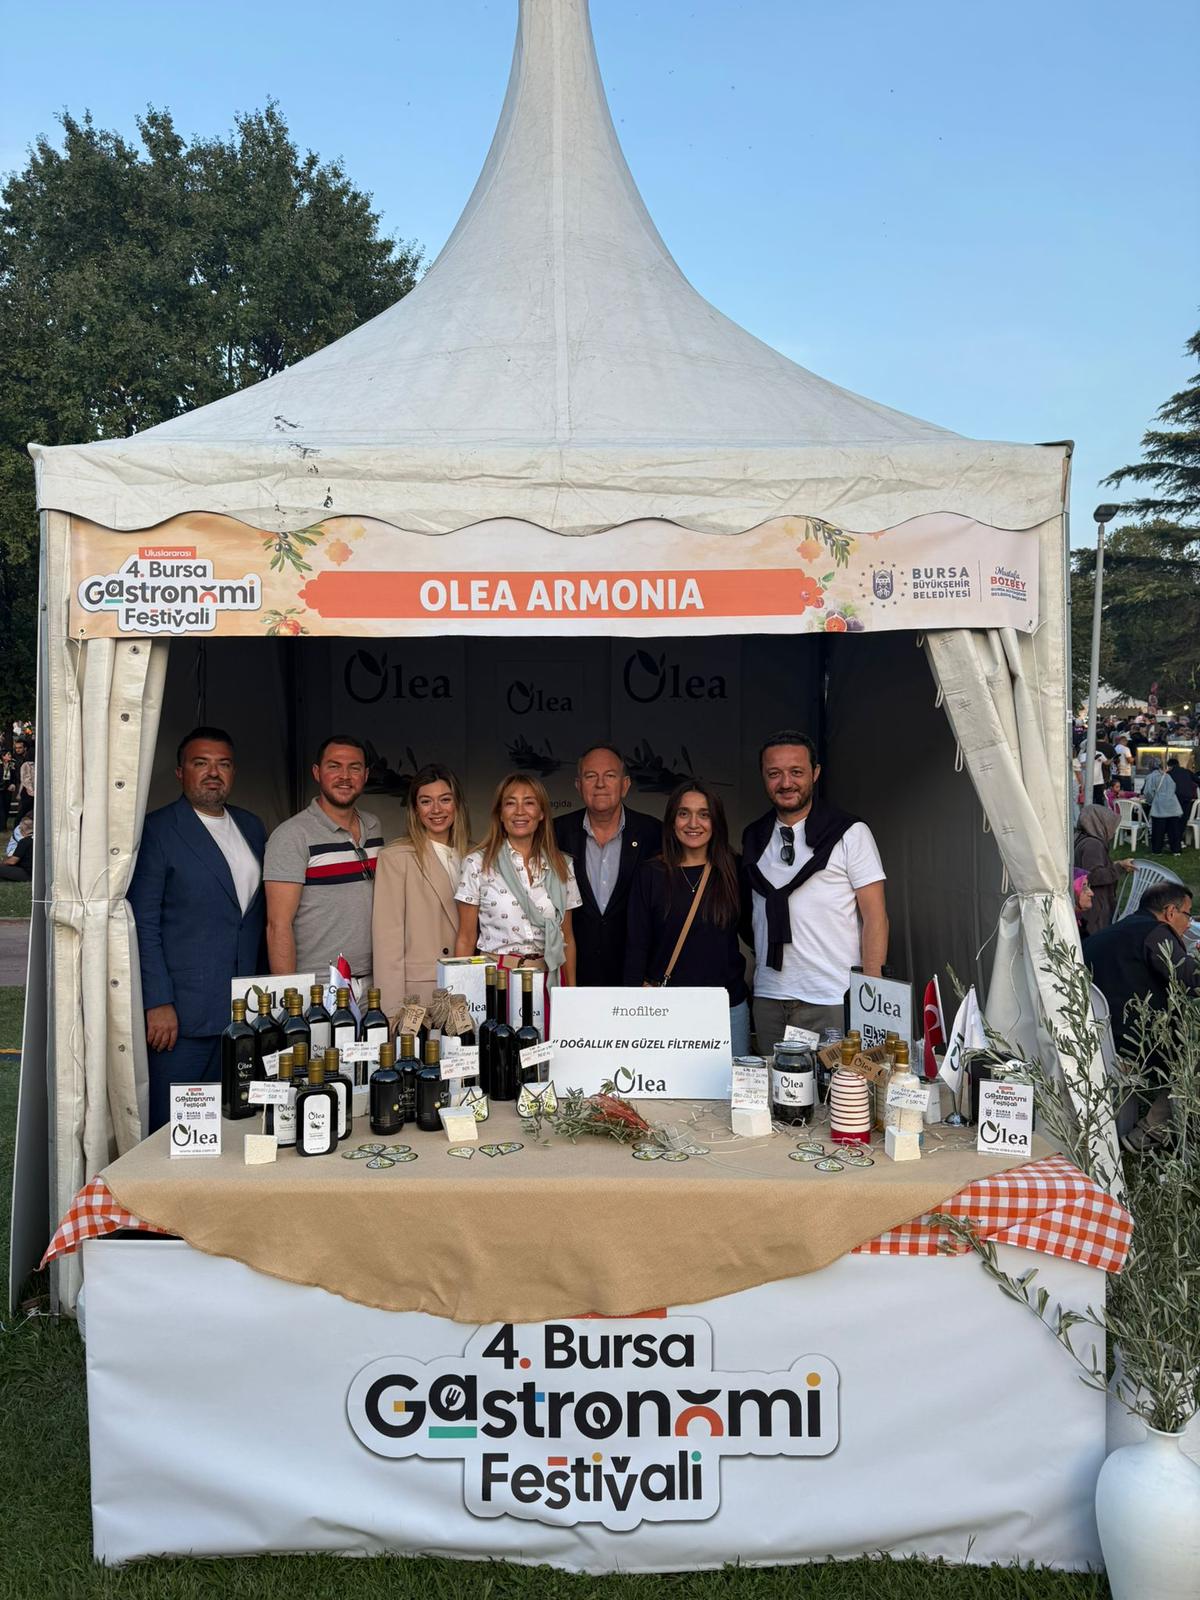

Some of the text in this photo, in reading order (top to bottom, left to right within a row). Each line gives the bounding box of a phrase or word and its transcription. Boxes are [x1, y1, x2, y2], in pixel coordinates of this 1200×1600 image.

[126, 561, 207, 578] 4. Bursa
[912, 566, 970, 579] BURSA
[85, 579, 255, 605] Gastronomi
[420, 578, 705, 611] OLEA ARMONIA
[913, 578, 970, 589] BÜYÜKŞEHİR
[913, 588, 971, 599] BELEDİYESİ
[990, 576, 1027, 590] BOZBEY
[125, 607, 210, 628] Festivali
[344, 649, 453, 704] Olea
[624, 649, 728, 704] Olea
[507, 680, 574, 715] Olea
[611, 1006, 669, 1017] #nofilter
[859, 982, 901, 1018] Olea
[559, 1037, 722, 1050] DOĞALLIK EN GÜZEL FİLTREMİZ
[854, 1057, 872, 1072] Olea
[614, 1066, 667, 1094] Olea
[781, 1075, 804, 1089] Olea
[172, 1123, 218, 1147] Olea
[980, 1120, 1028, 1146] Olea
[482, 1323, 695, 1370] 4. Bursa
[365, 1372, 822, 1440] Gastronomi
[482, 1450, 703, 1512] Festivali
